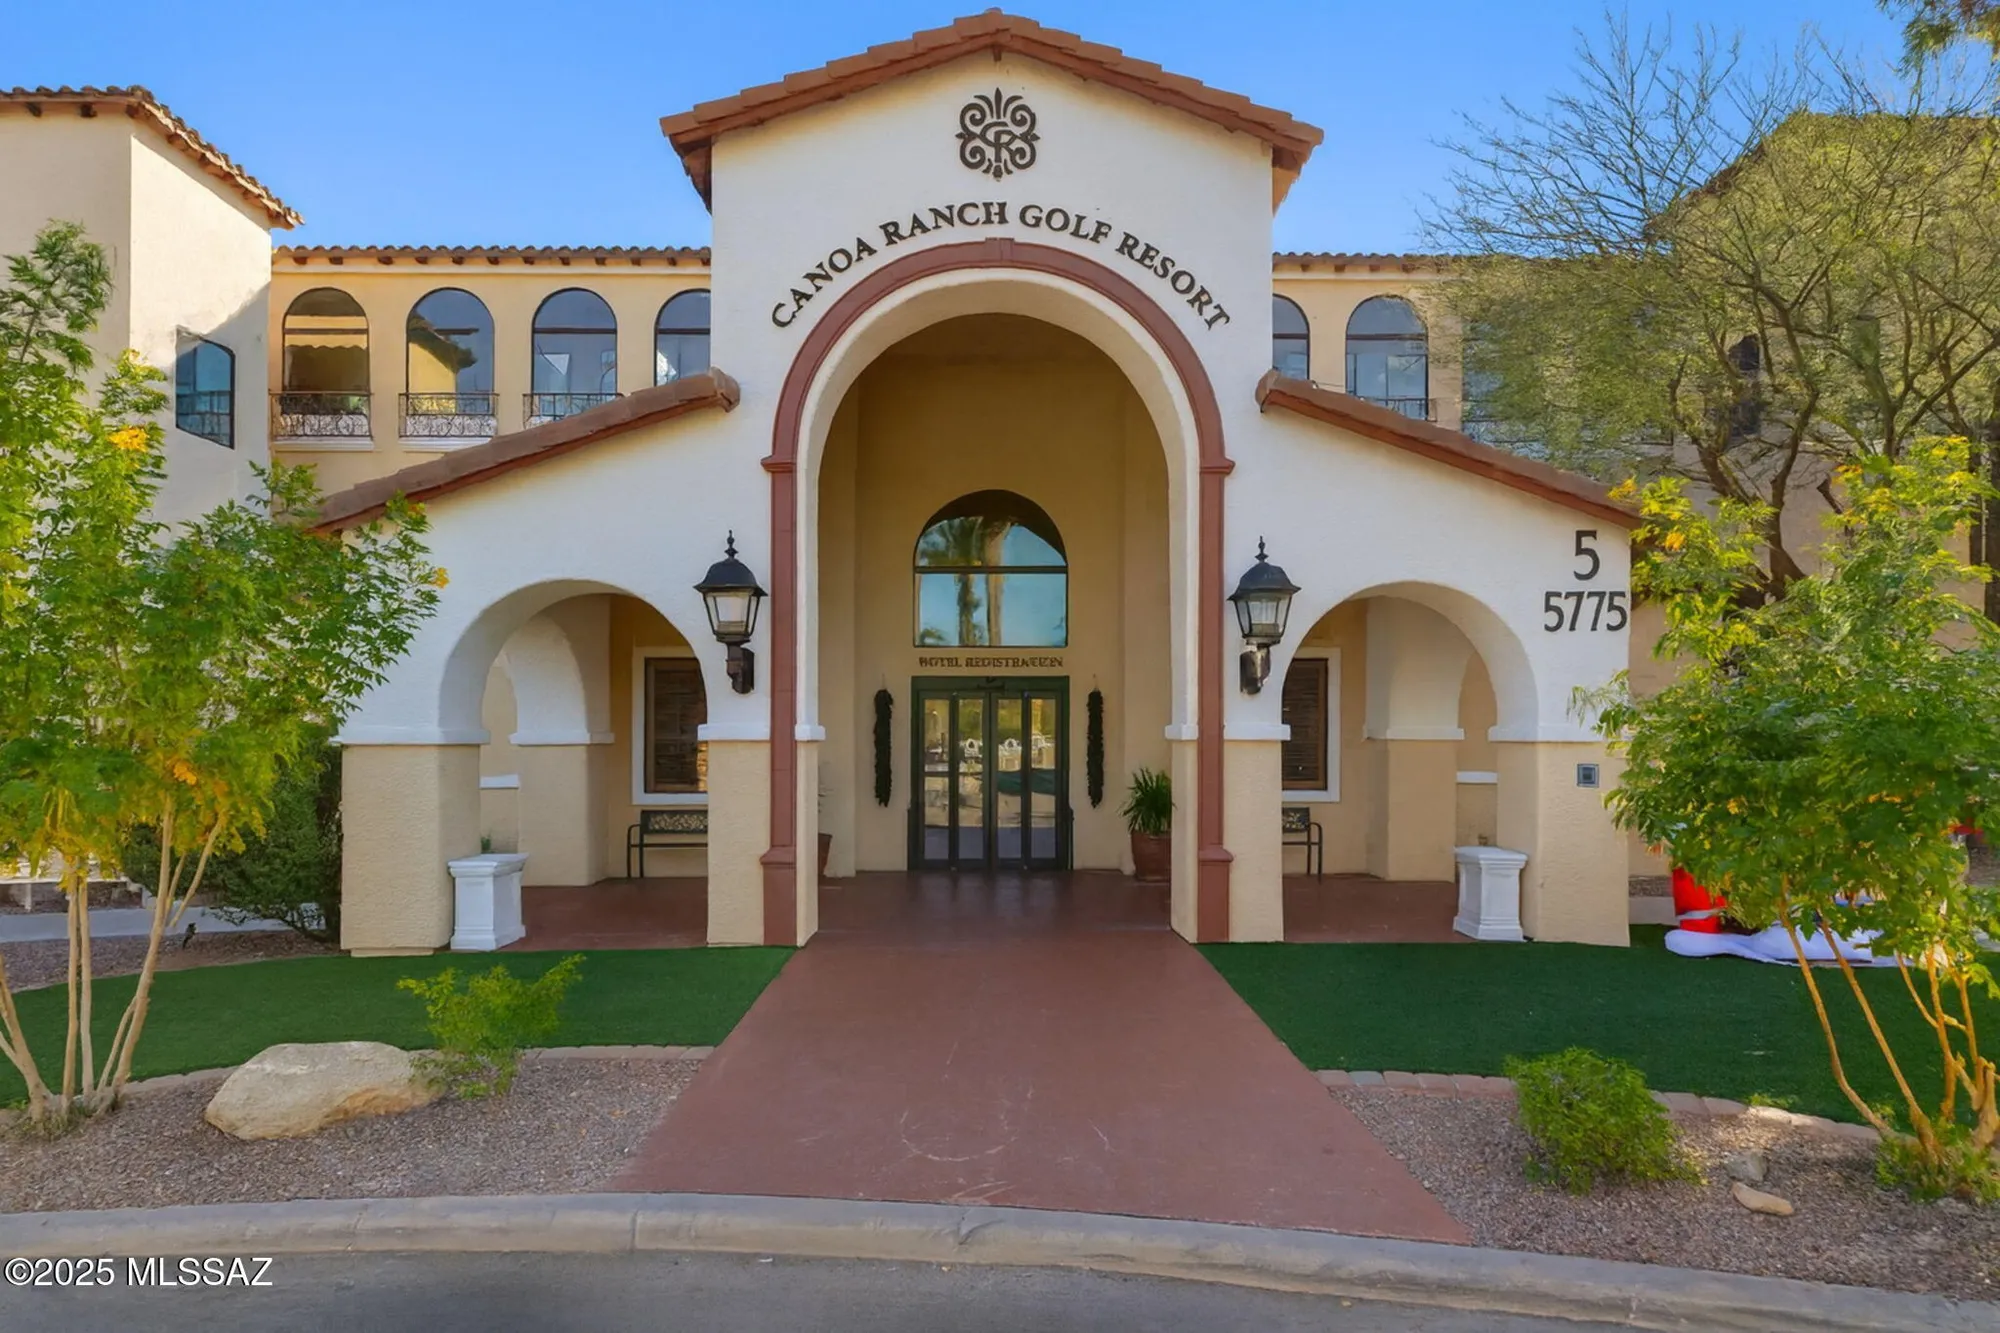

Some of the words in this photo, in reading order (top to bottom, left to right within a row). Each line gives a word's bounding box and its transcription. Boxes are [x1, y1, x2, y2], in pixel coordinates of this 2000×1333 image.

[771, 236, 877, 328] CANOA
[879, 201, 1010, 248] RANCH
[1018, 204, 1112, 244] GOLF
[1114, 230, 1231, 330] RESORT
[1573, 529, 1601, 581] 5
[1544, 590, 1628, 632] 5775
[918, 656, 962, 668] HOTEL
